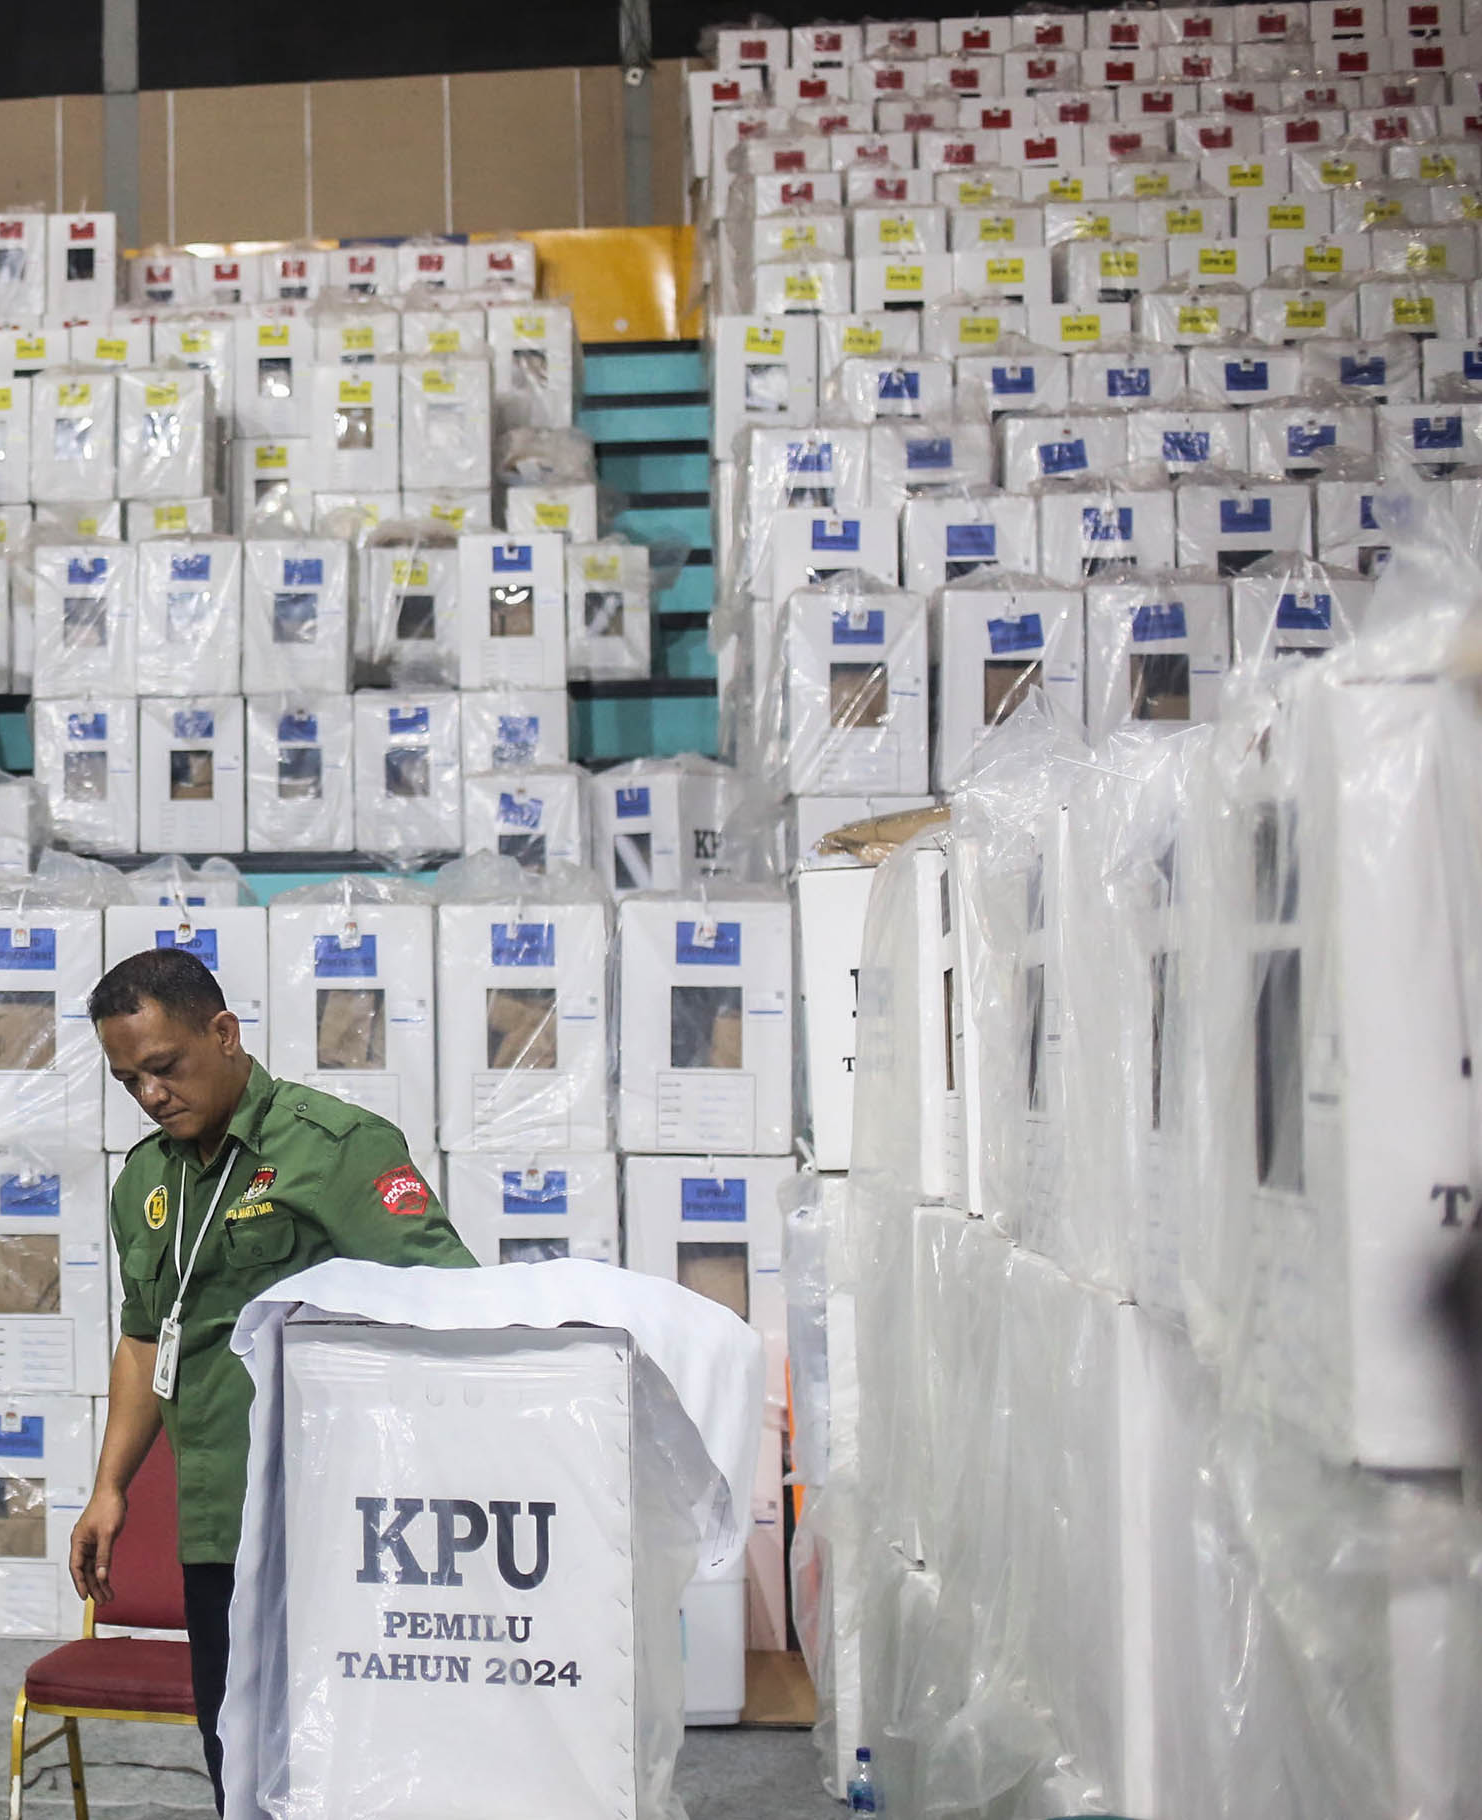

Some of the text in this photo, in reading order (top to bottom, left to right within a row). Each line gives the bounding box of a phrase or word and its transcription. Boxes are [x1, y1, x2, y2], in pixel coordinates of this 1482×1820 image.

[355, 1496, 557, 1591] KPU
[383, 1611, 533, 1644] PEMILU
[336, 1651, 582, 1688] TAHUN 2024
